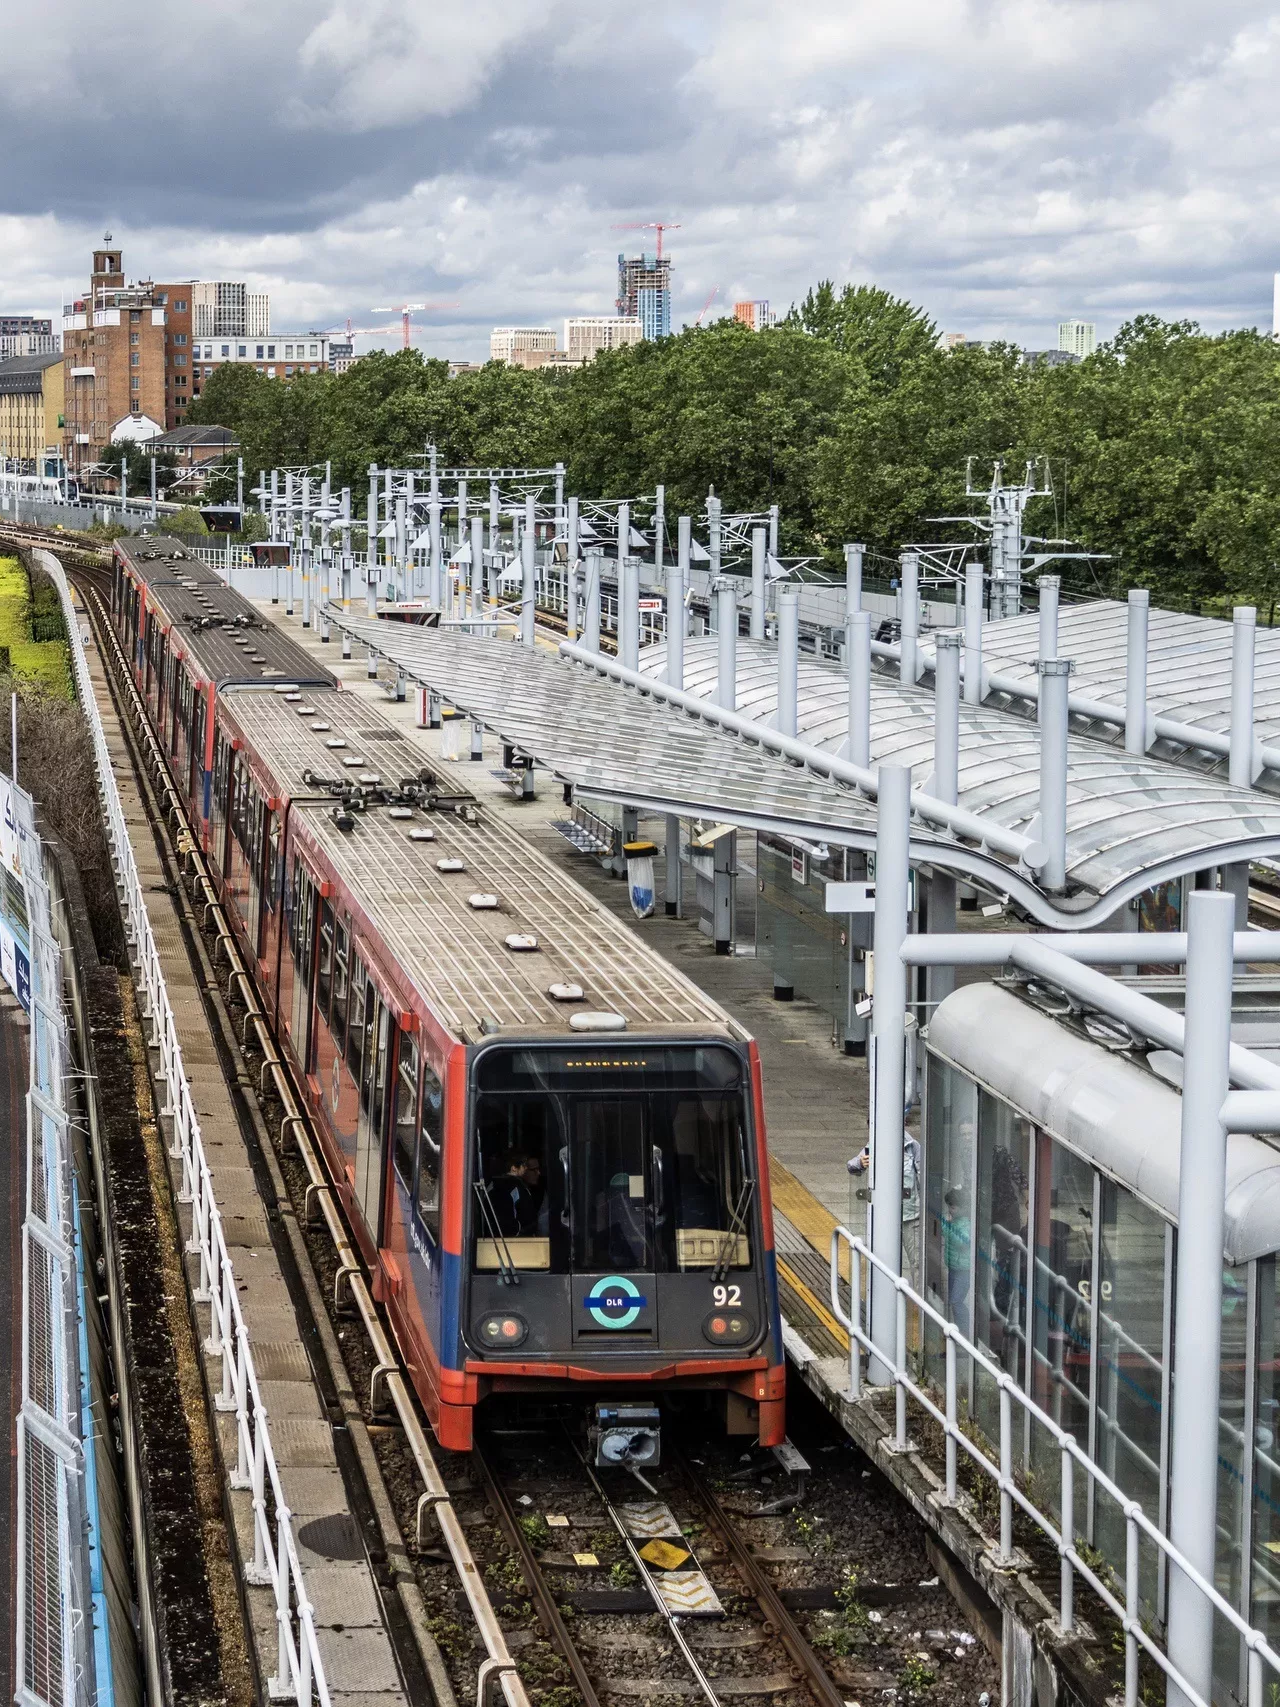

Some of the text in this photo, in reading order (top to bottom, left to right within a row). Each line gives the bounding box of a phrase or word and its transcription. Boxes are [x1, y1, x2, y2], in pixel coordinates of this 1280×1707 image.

[712, 1284, 742, 1307] 92
[606, 1298, 623, 1306] DLR
[759, 1388, 765, 1396] B
